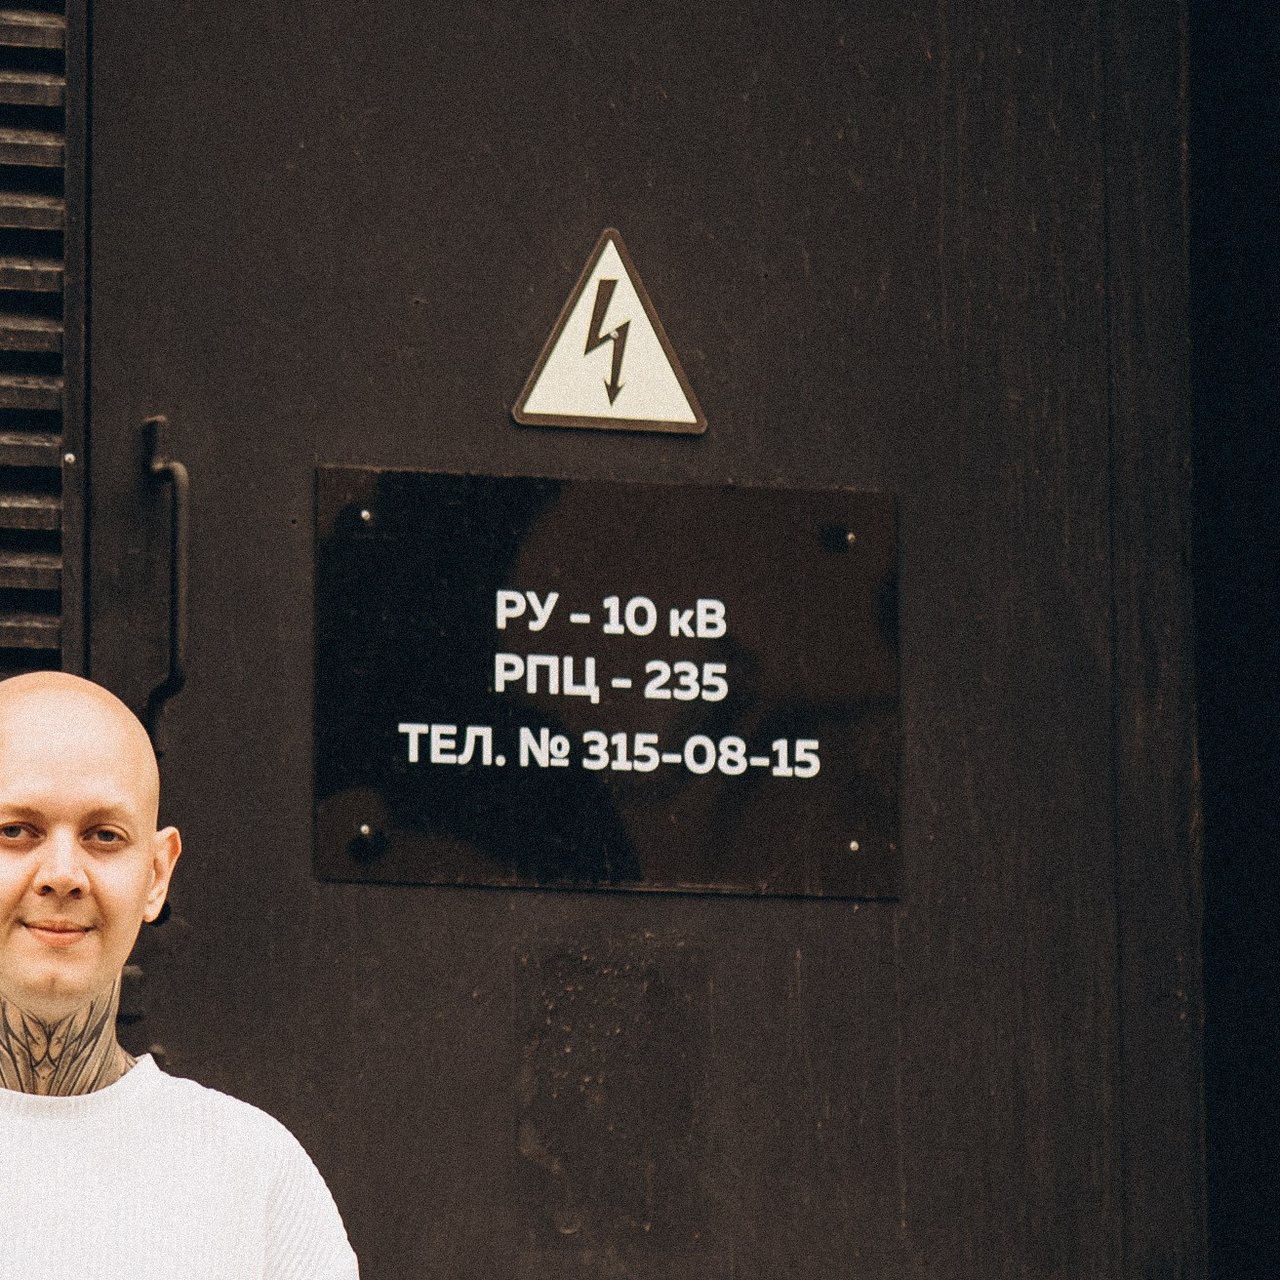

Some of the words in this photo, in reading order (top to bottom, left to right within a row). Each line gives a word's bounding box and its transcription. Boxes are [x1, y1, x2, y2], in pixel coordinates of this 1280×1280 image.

[495, 589, 560, 632] РУ
[601, 595, 659, 636] 10
[668, 598, 728, 639] кВ
[493, 652, 601, 704] РПЦ
[642, 659, 730, 703] 235
[396, 722, 507, 767] ТЕЛ.
[518, 726, 571, 768] №
[581, 730, 822, 779] 315-08-15
